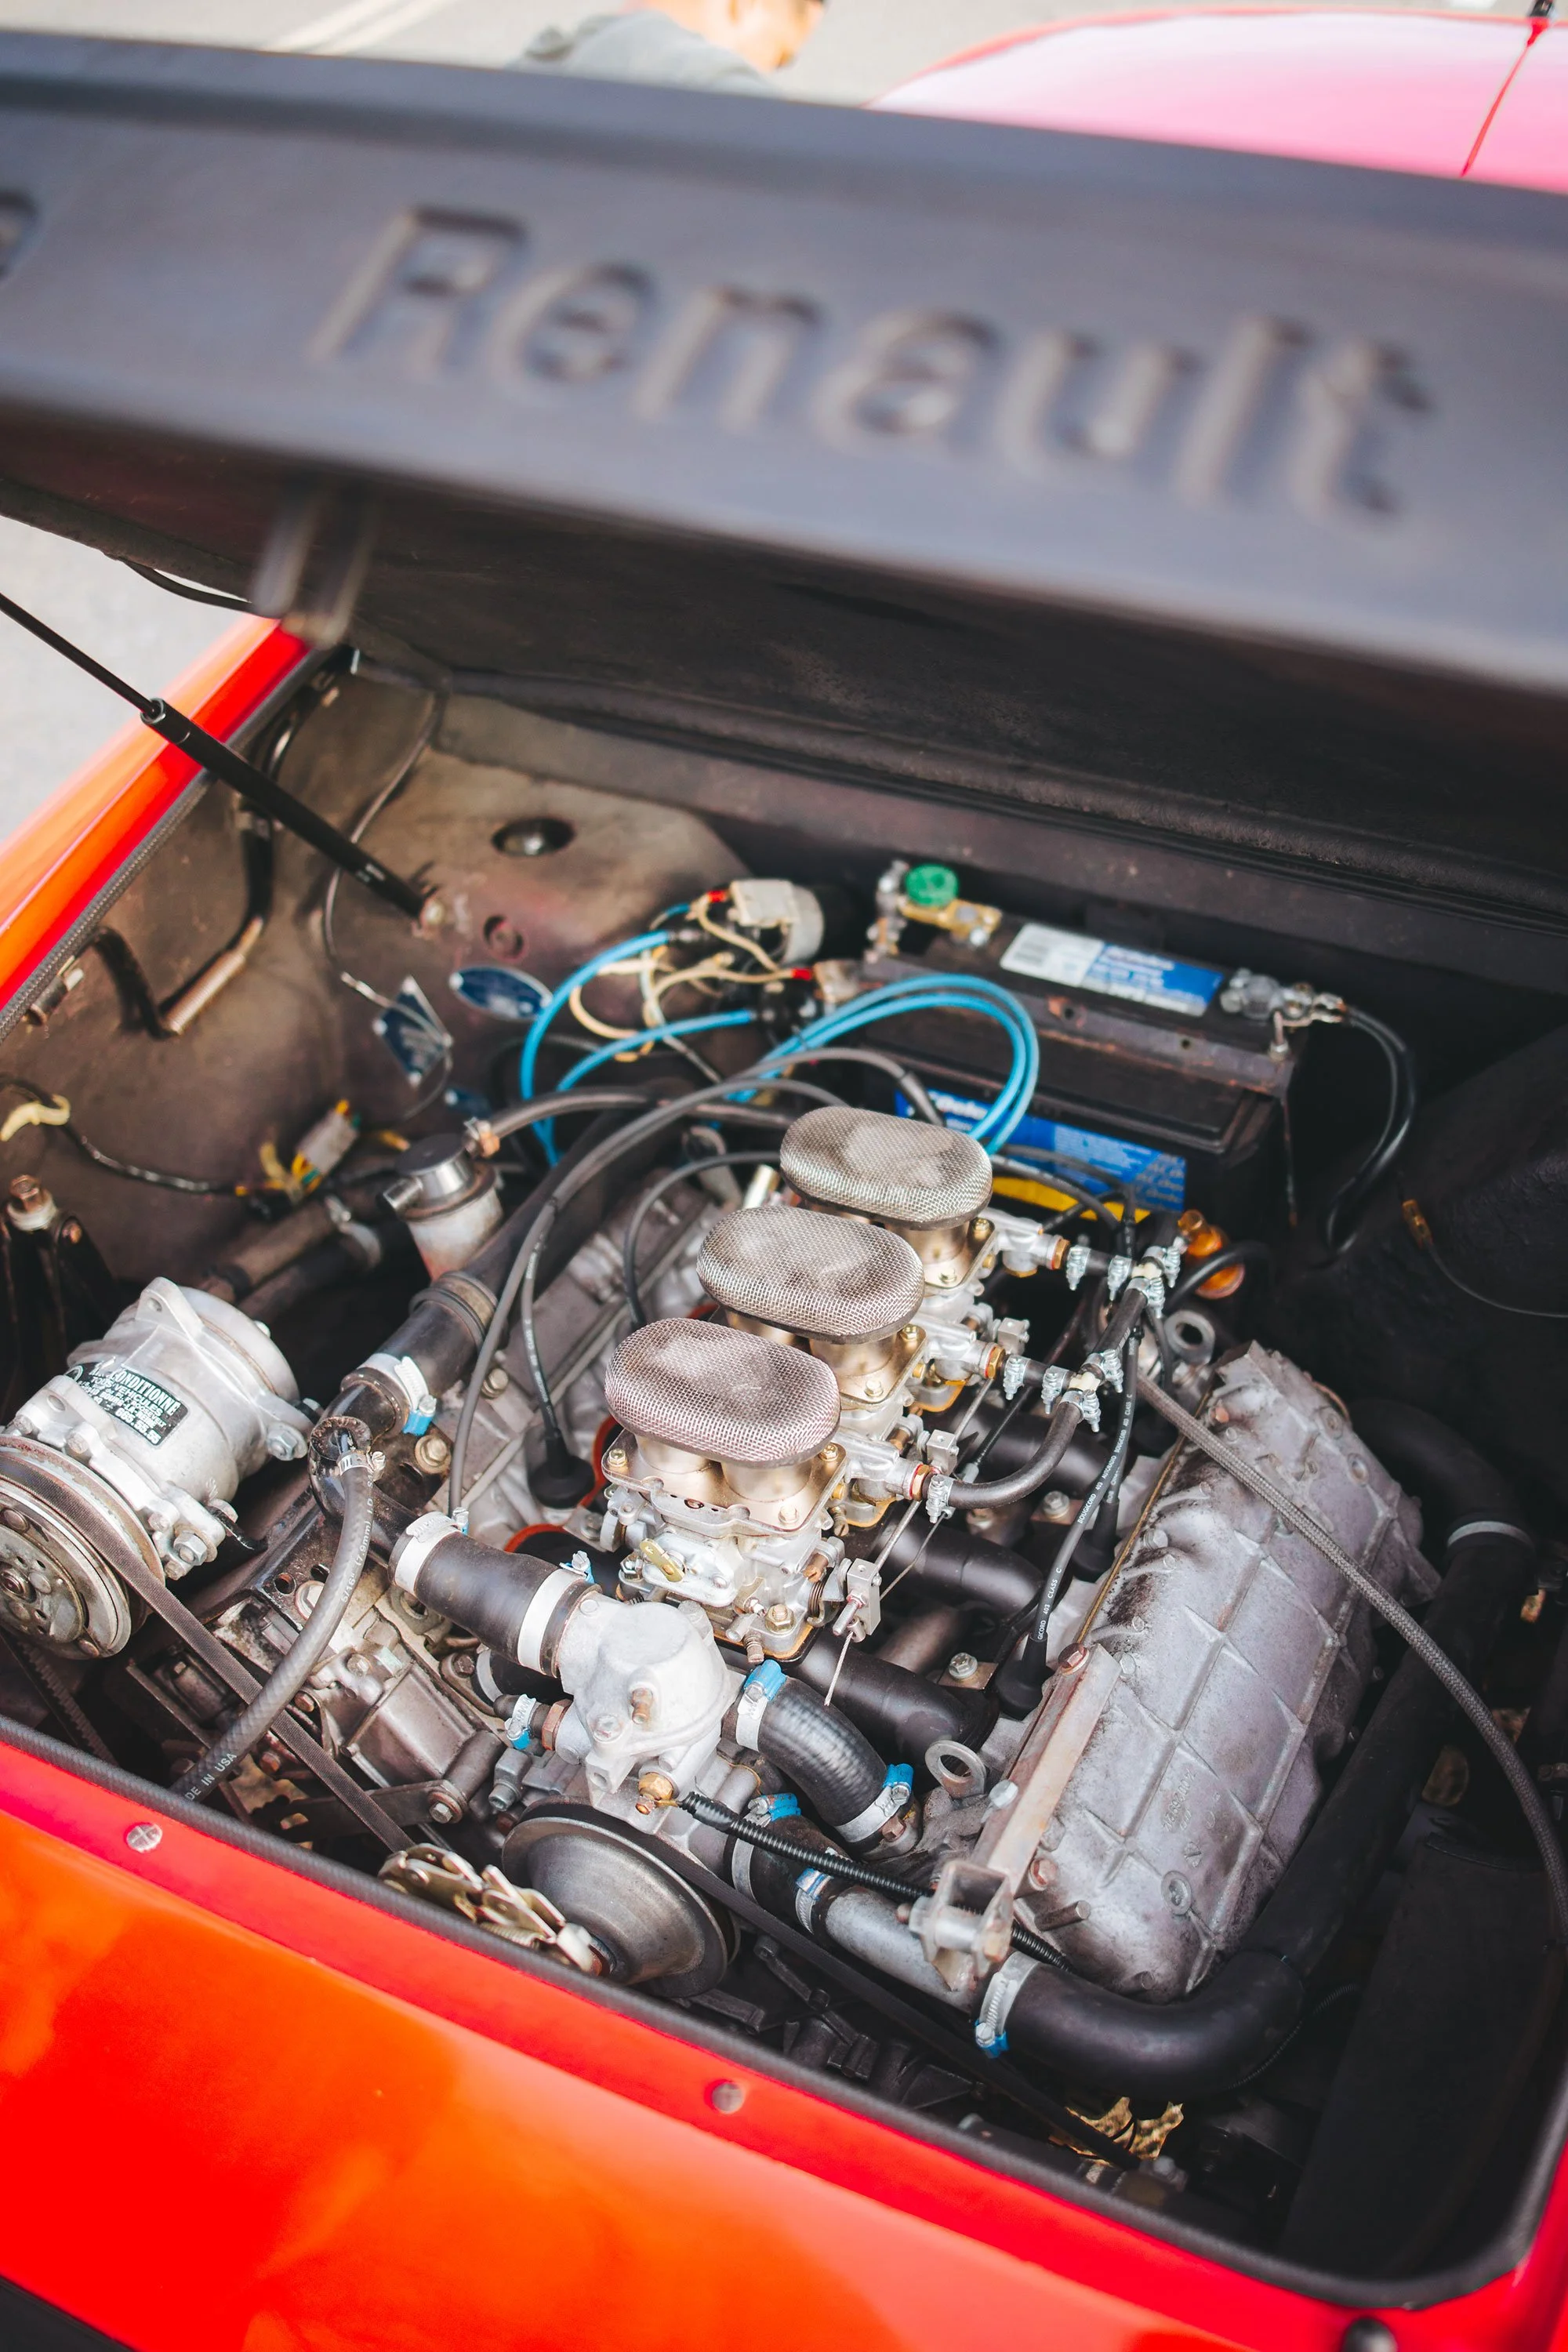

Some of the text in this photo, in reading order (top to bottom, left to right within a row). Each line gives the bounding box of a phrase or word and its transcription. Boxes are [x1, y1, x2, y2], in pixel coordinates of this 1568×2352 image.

[306, 204, 1433, 517] Renault
[114, 1384, 163, 1417] VEHICULES
[130, 1399, 167, 1428] ROOSEVELT
[1077, 1494, 1096, 1524] BOUGICORD
[340, 1573, 356, 1602] 5/16"
[355, 1521, 372, 1566] (7.9mm)
[1037, 1620, 1047, 1640] GICORD
[1047, 1579, 1058, 1599] CLASS
[184, 1752, 237, 1801] DE IN USA
